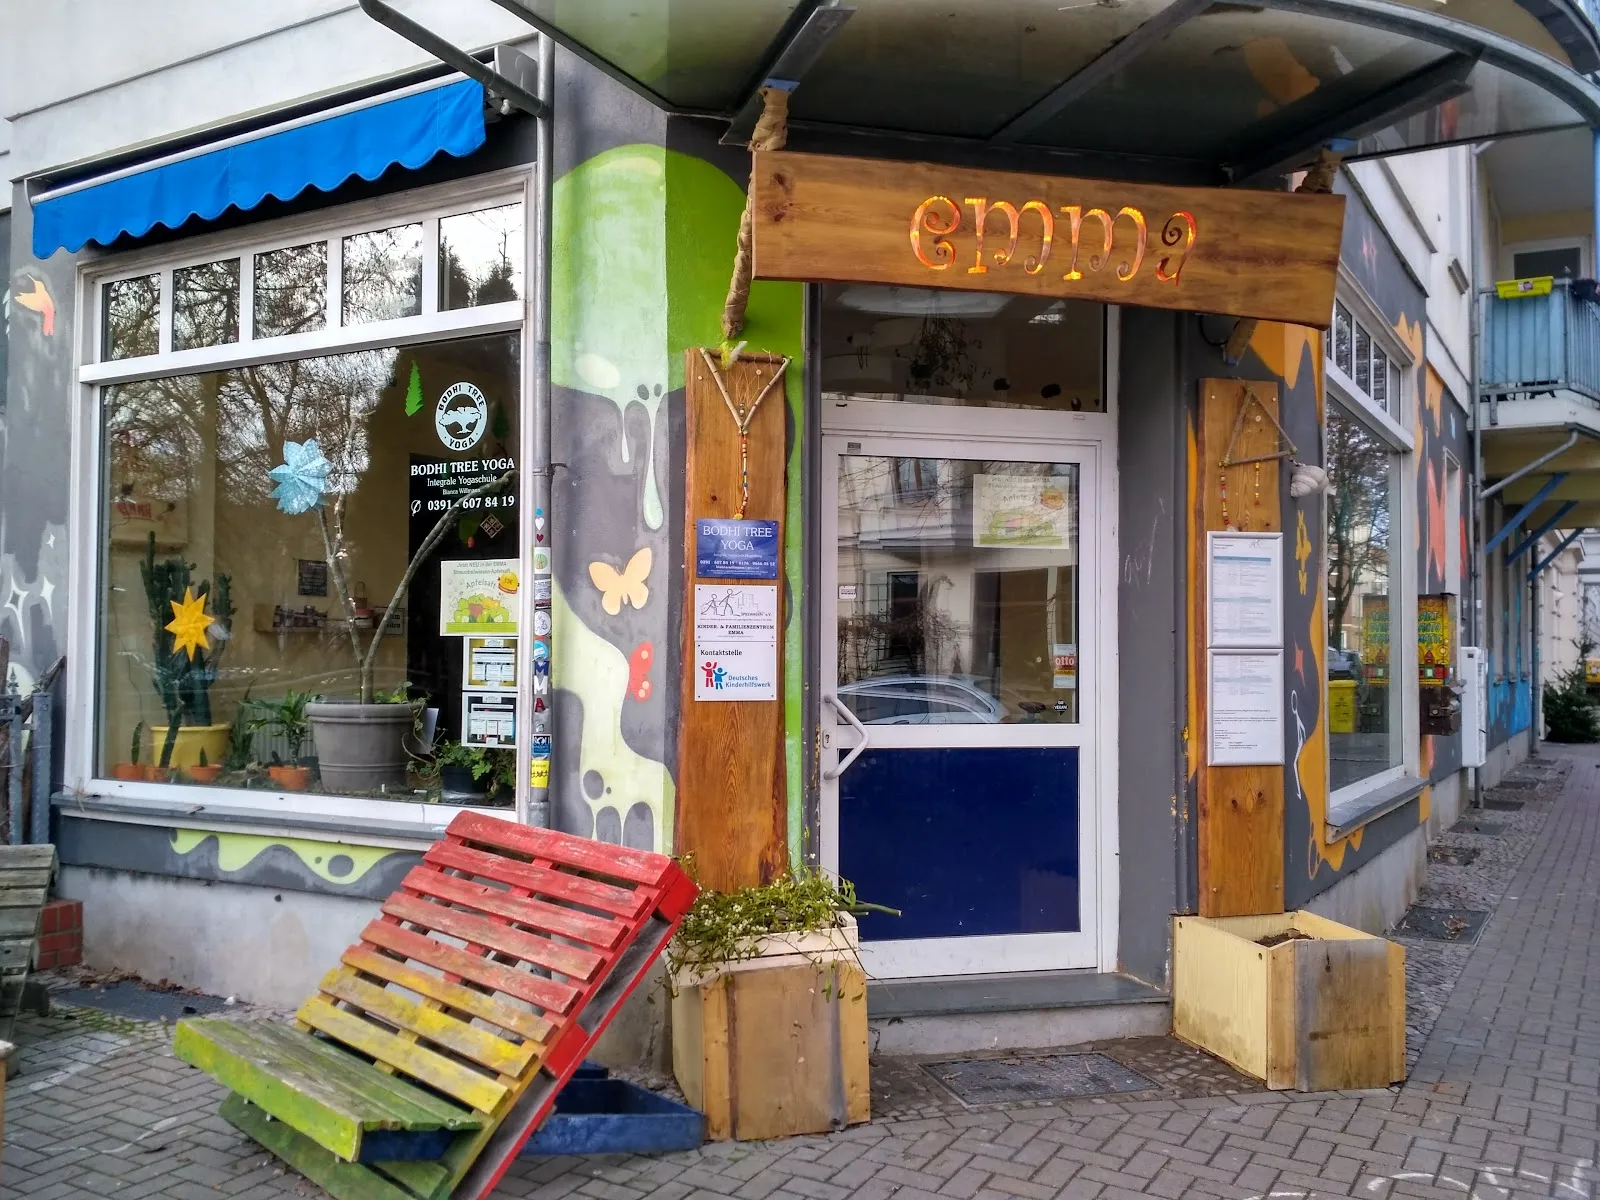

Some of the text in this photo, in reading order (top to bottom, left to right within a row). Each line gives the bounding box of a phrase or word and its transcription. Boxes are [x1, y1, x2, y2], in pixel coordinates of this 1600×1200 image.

[909, 195, 1197, 287] emma
[438, 384, 485, 411] BODHI TREE
[448, 437, 475, 449] YOGA
[410, 458, 515, 476] BODHI TREE YOGA
[427, 474, 498, 488] Integrale Yogaschule
[427, 499, 452, 512] 0391
[462, 498, 482, 509] 607
[485, 497, 498, 508] 84
[502, 495, 515, 507] 19
[703, 525, 773, 538] BODHI TREE
[720, 540, 755, 551] YOGA
[466, 579, 497, 590] Apfelsaft
[1055, 656, 1075, 666] otto
